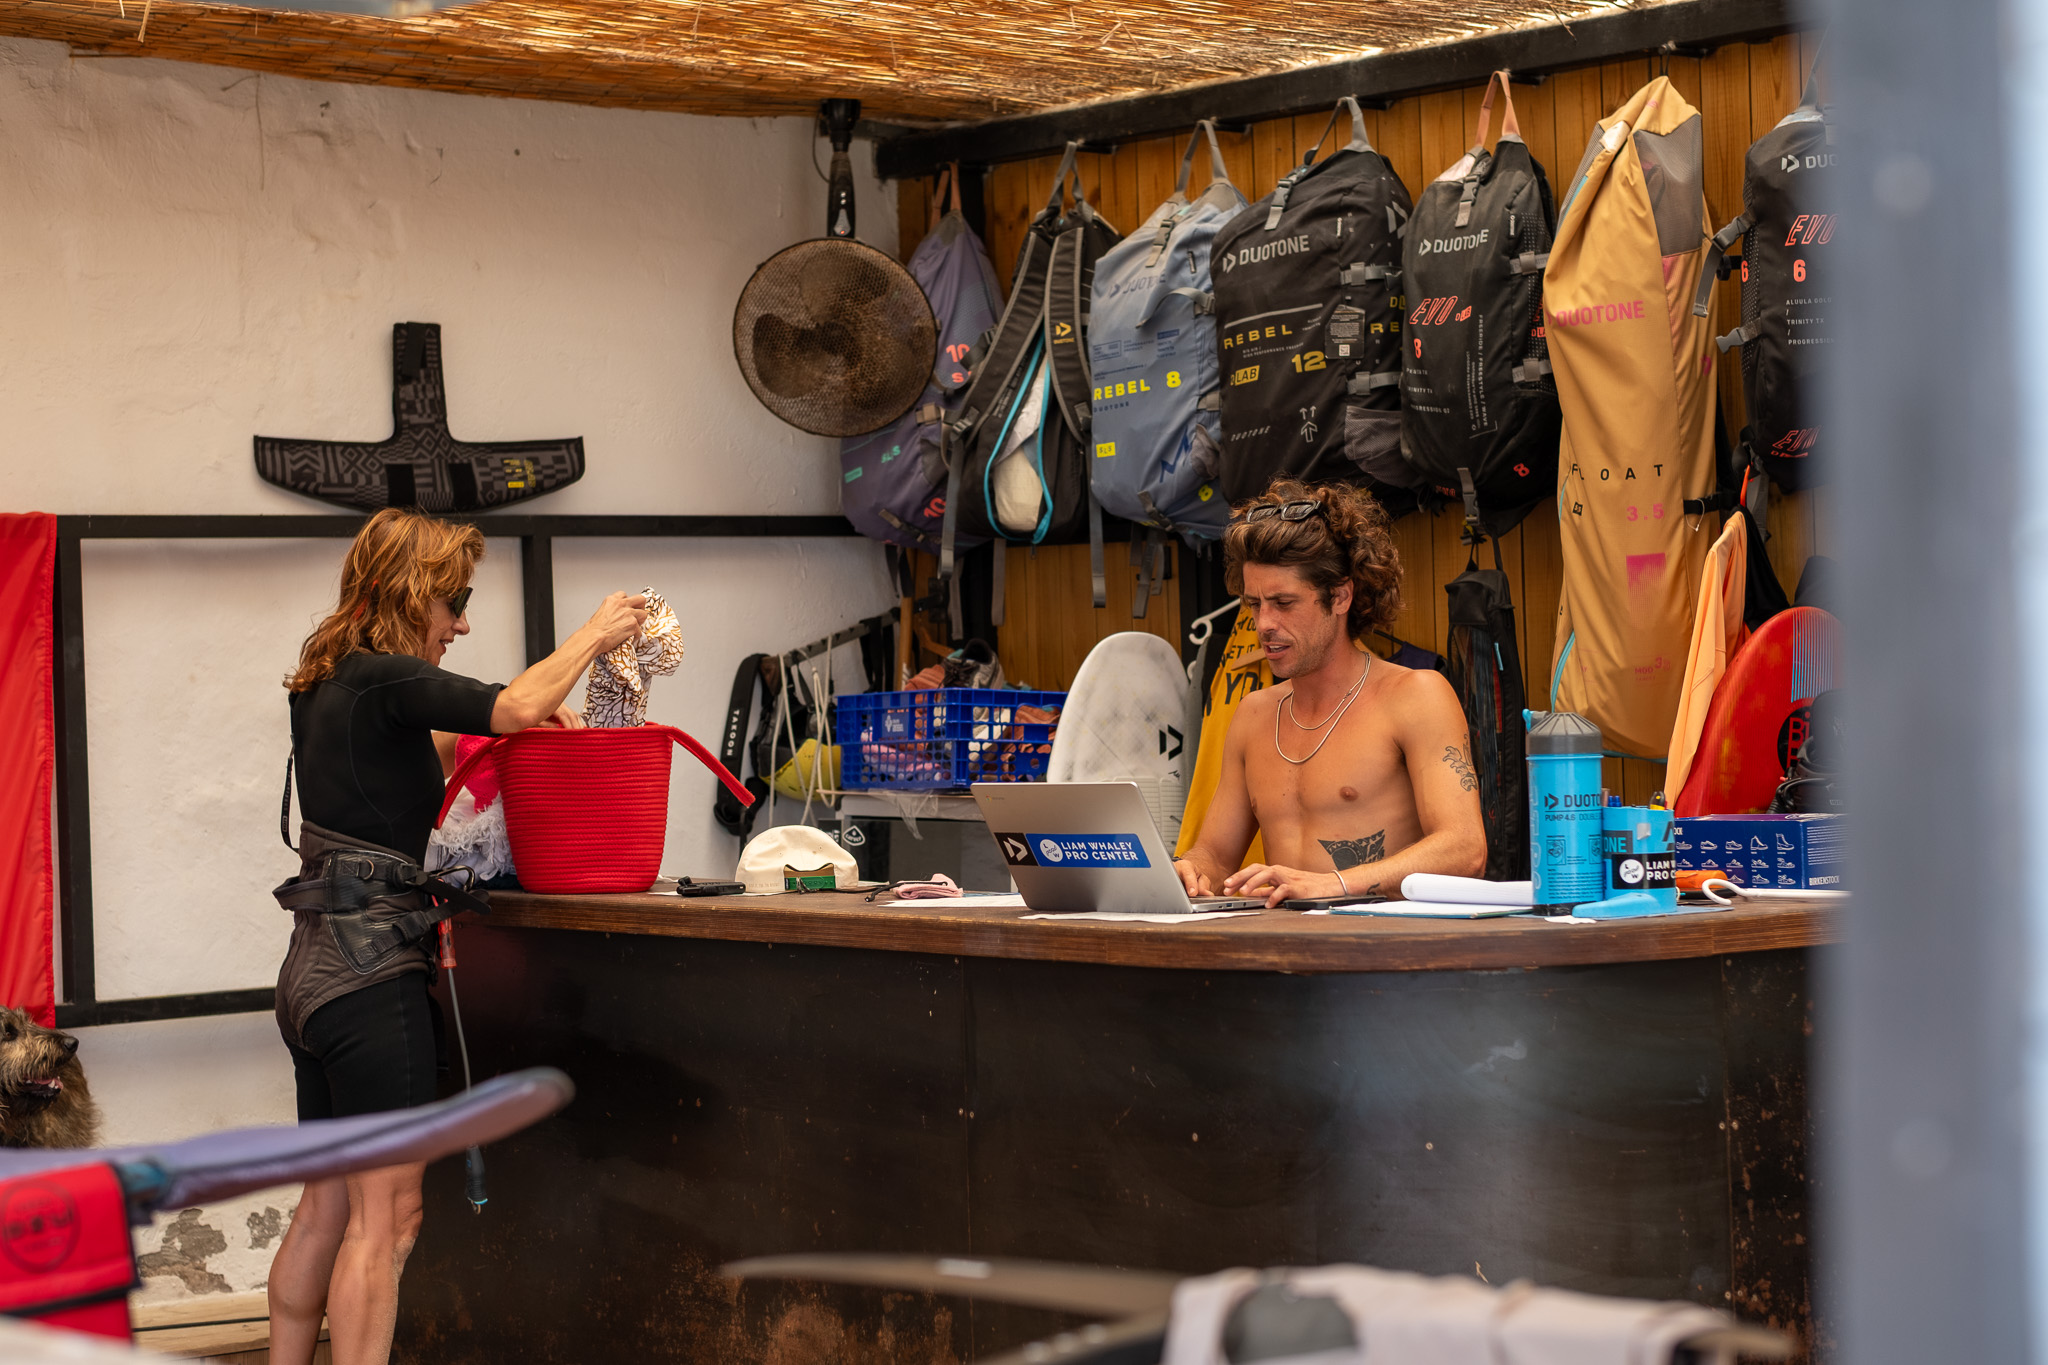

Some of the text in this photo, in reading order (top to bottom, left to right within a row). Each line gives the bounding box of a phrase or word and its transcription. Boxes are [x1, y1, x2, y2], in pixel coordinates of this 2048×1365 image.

[1239, 235, 1311, 266] DUOTONE
[1741, 260, 1749, 283] 6
[1793, 259, 1806, 283] 6
[1409, 295, 1459, 326] EVO
[1224, 325, 1293, 349] REBEL
[1414, 338, 1422, 359] 8
[1291, 350, 1327, 374] 12
[1093, 379, 1151, 401] REBEL
[1166, 371, 1181, 388] 8
[1198, 484, 1213, 502] 8
[1626, 502, 1665, 522] 3.5
[726, 709, 740, 757] TAKOON
[1060, 841, 1086, 850] LIAM
[1088, 841, 1132, 851] WHALEY
[1064, 851, 1139, 861] PRO CENTER
[1646, 870, 1669, 881] PRO
